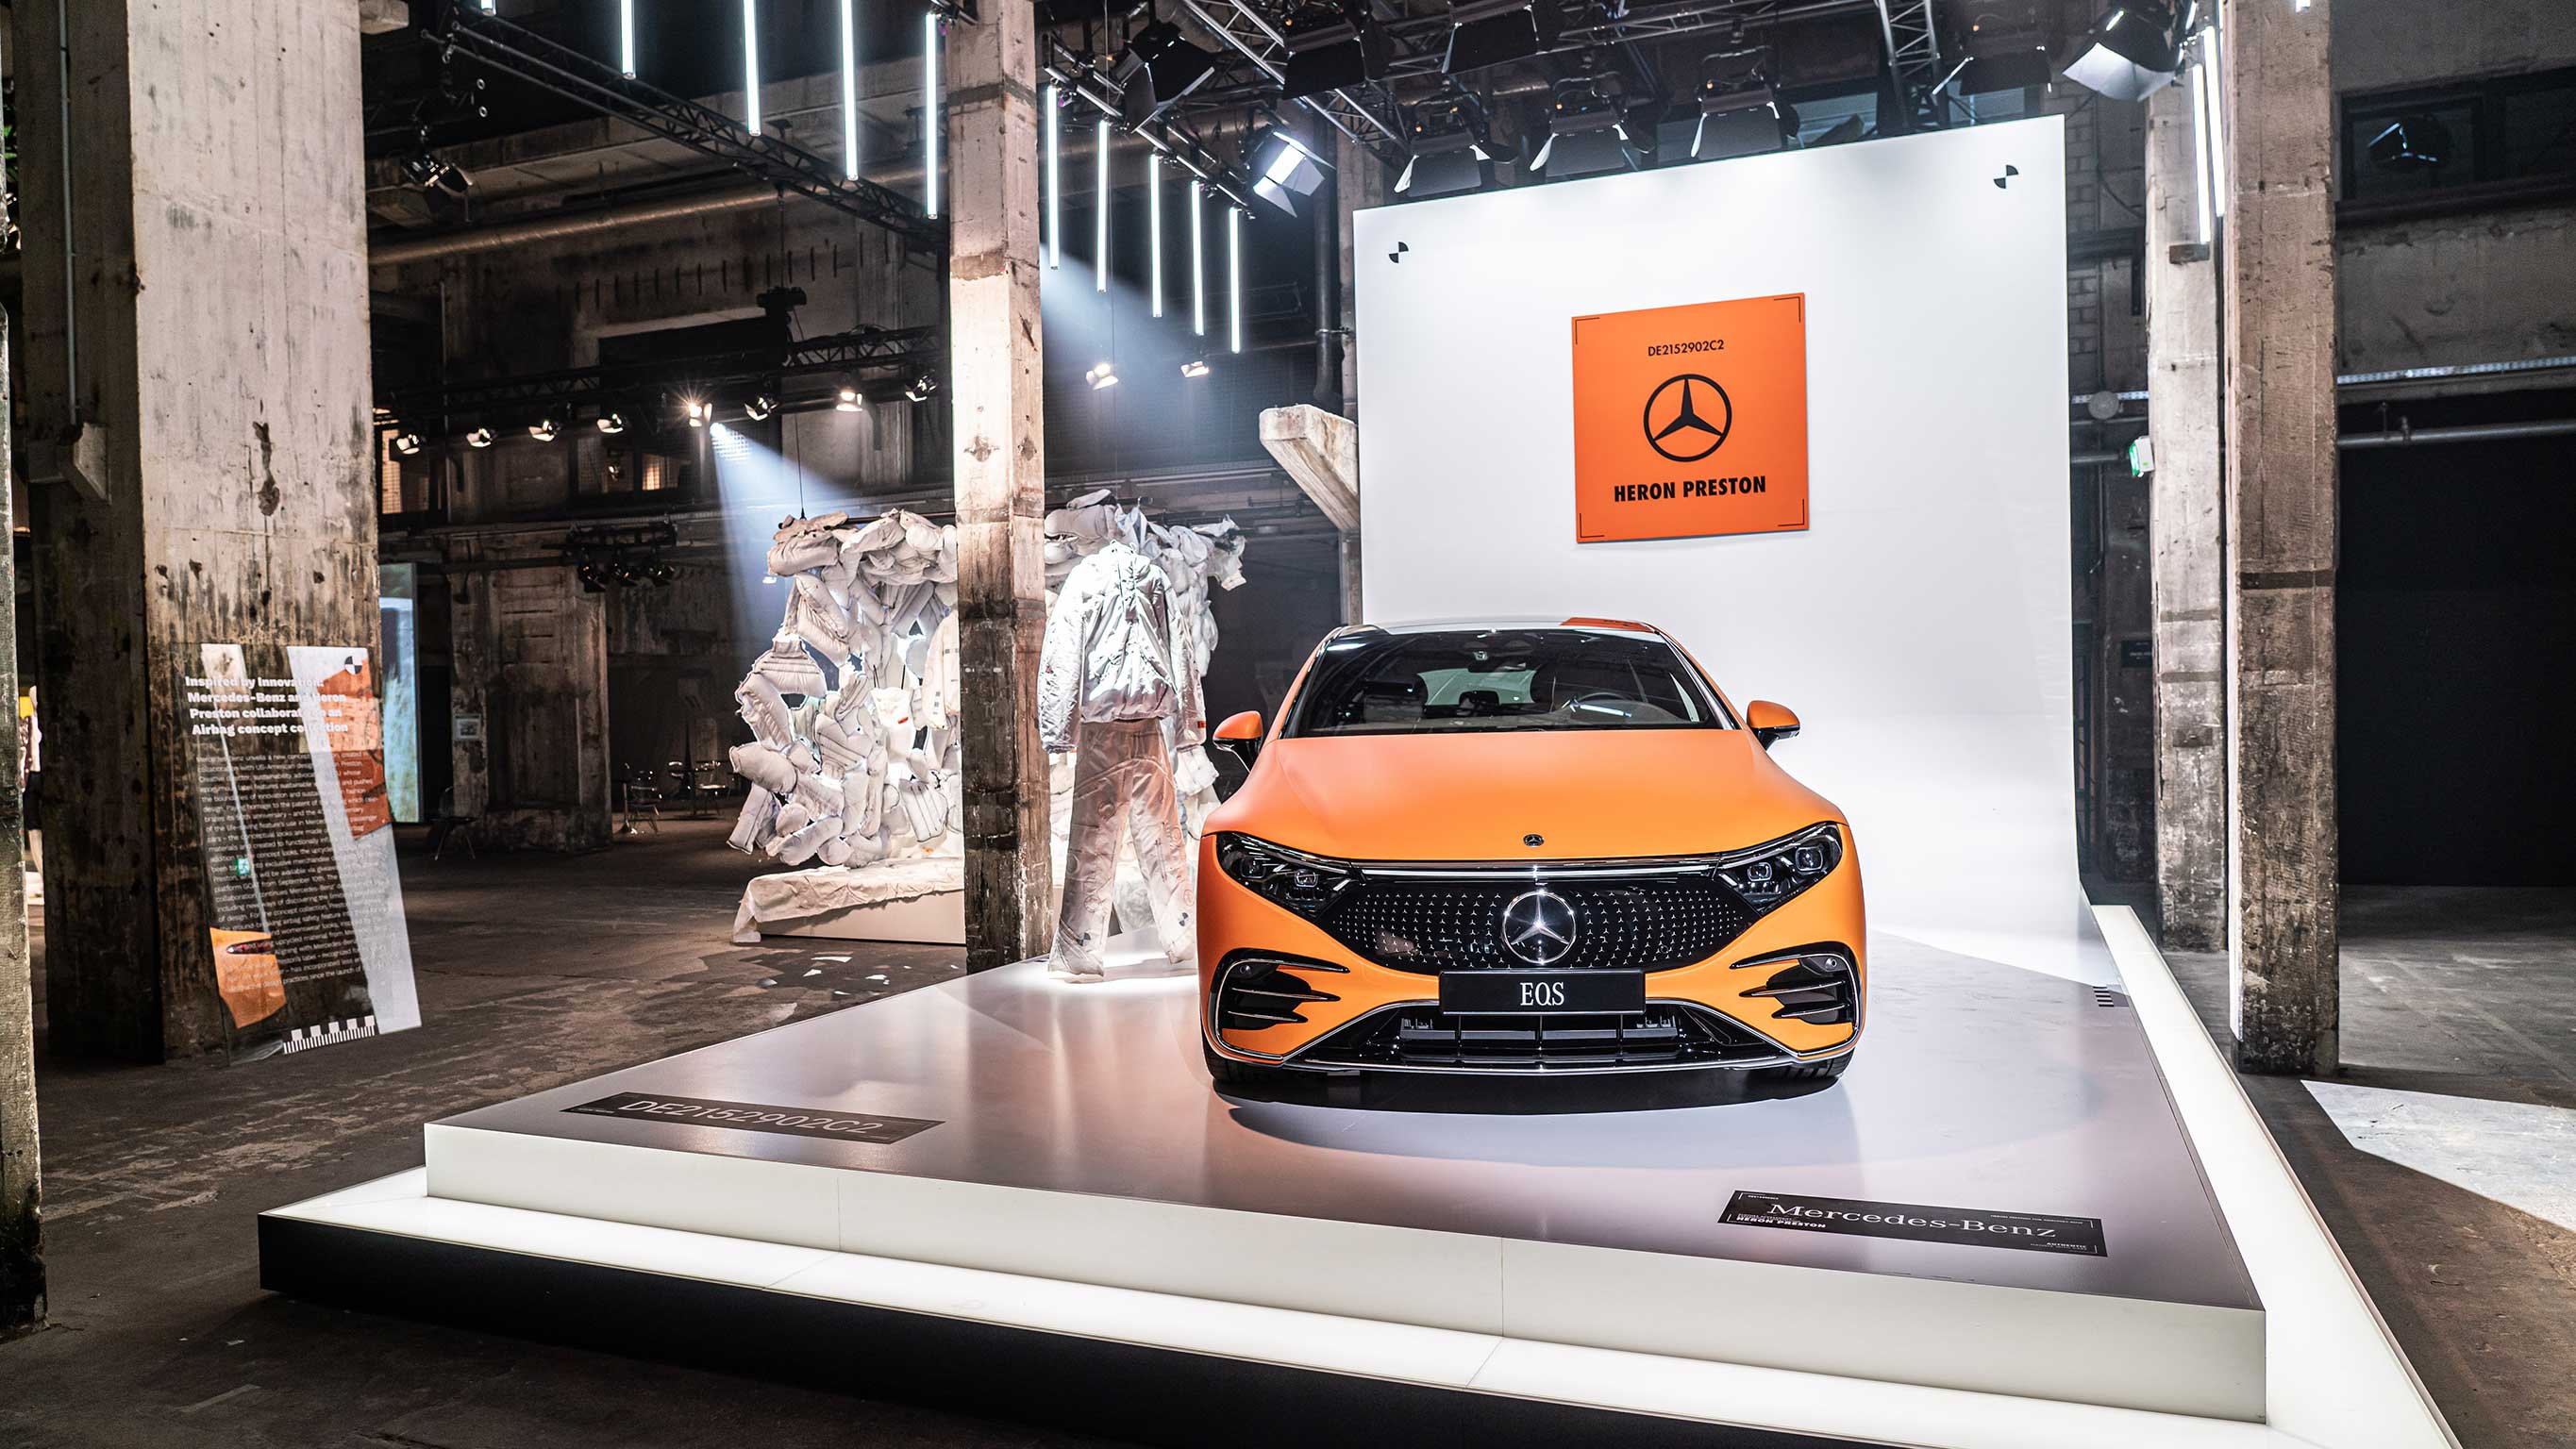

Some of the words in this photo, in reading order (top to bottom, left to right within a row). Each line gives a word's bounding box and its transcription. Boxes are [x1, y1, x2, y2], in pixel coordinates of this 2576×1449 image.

[1648, 339, 1725, 357] DE2152902C2
[1614, 481, 1676, 502] HERON
[1683, 475, 1766, 497] PRESTON
[185, 675, 238, 689] Inspired
[241, 676, 255, 690] by
[187, 691, 286, 703] Mercedes-Benz
[190, 708, 240, 719] Preston
[192, 724, 236, 737] Airbag
[238, 724, 288, 736] concept
[290, 722, 348, 734] cotion
[1520, 982, 1564, 1006] EQS
[618, 1100, 883, 1134] DE2152902C2
[1766, 1204, 2057, 1238] Mercedes-Benz
